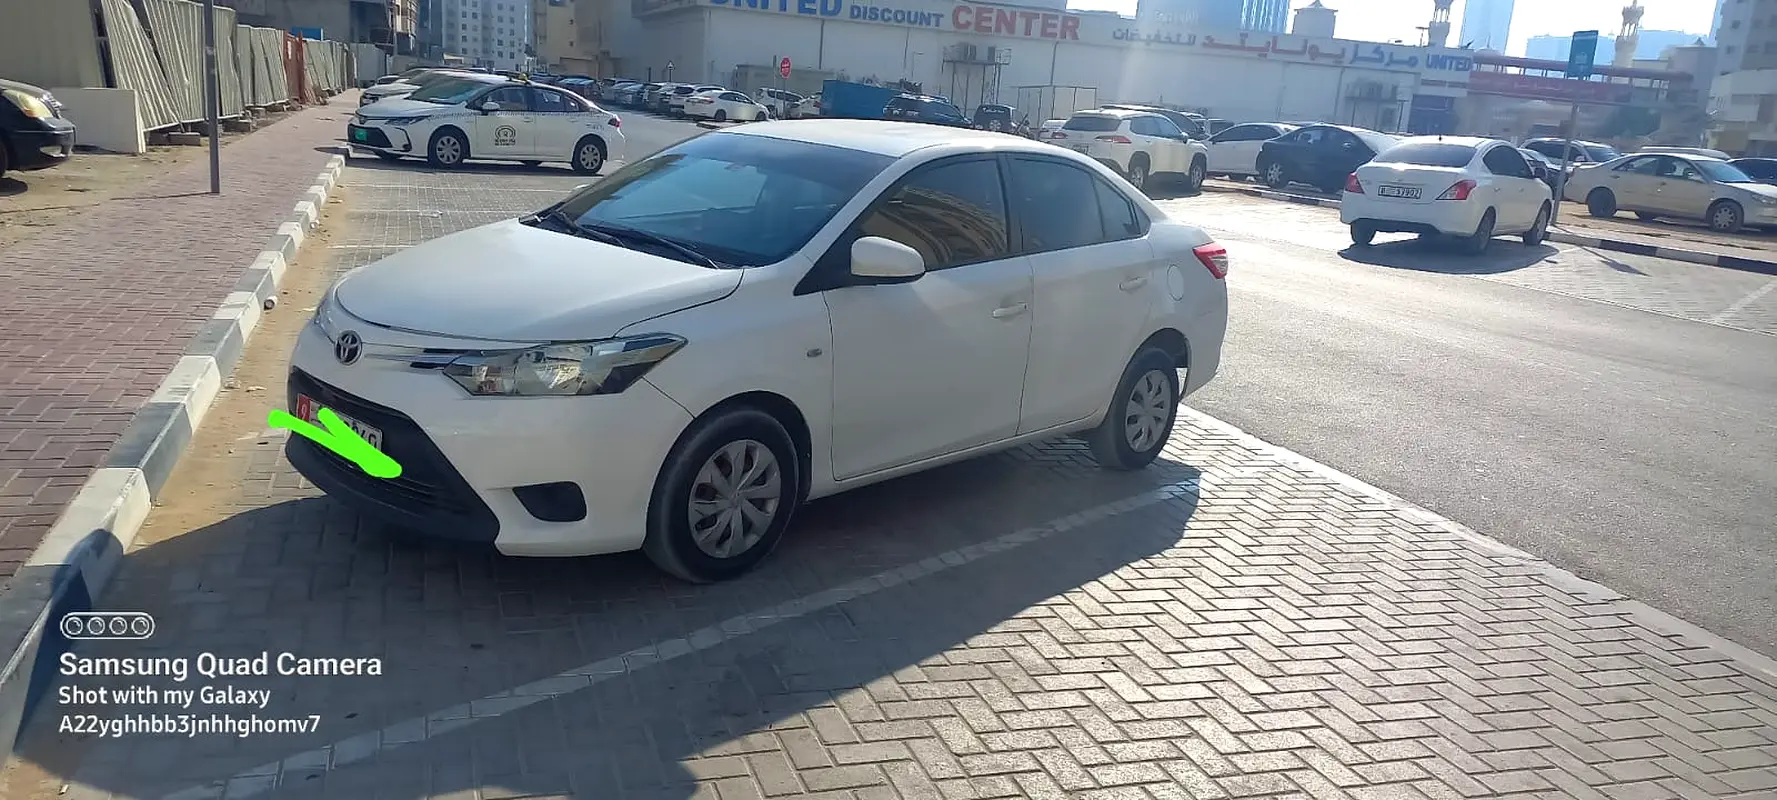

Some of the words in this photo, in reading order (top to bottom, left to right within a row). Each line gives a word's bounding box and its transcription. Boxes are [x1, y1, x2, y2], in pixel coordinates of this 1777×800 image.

[850, 5, 944, 27] DISCOUNT
[952, 5, 1080, 40] CENTER
[1350, 43, 1419, 68] مركز
[1425, 54, 1474, 72] UNITED
